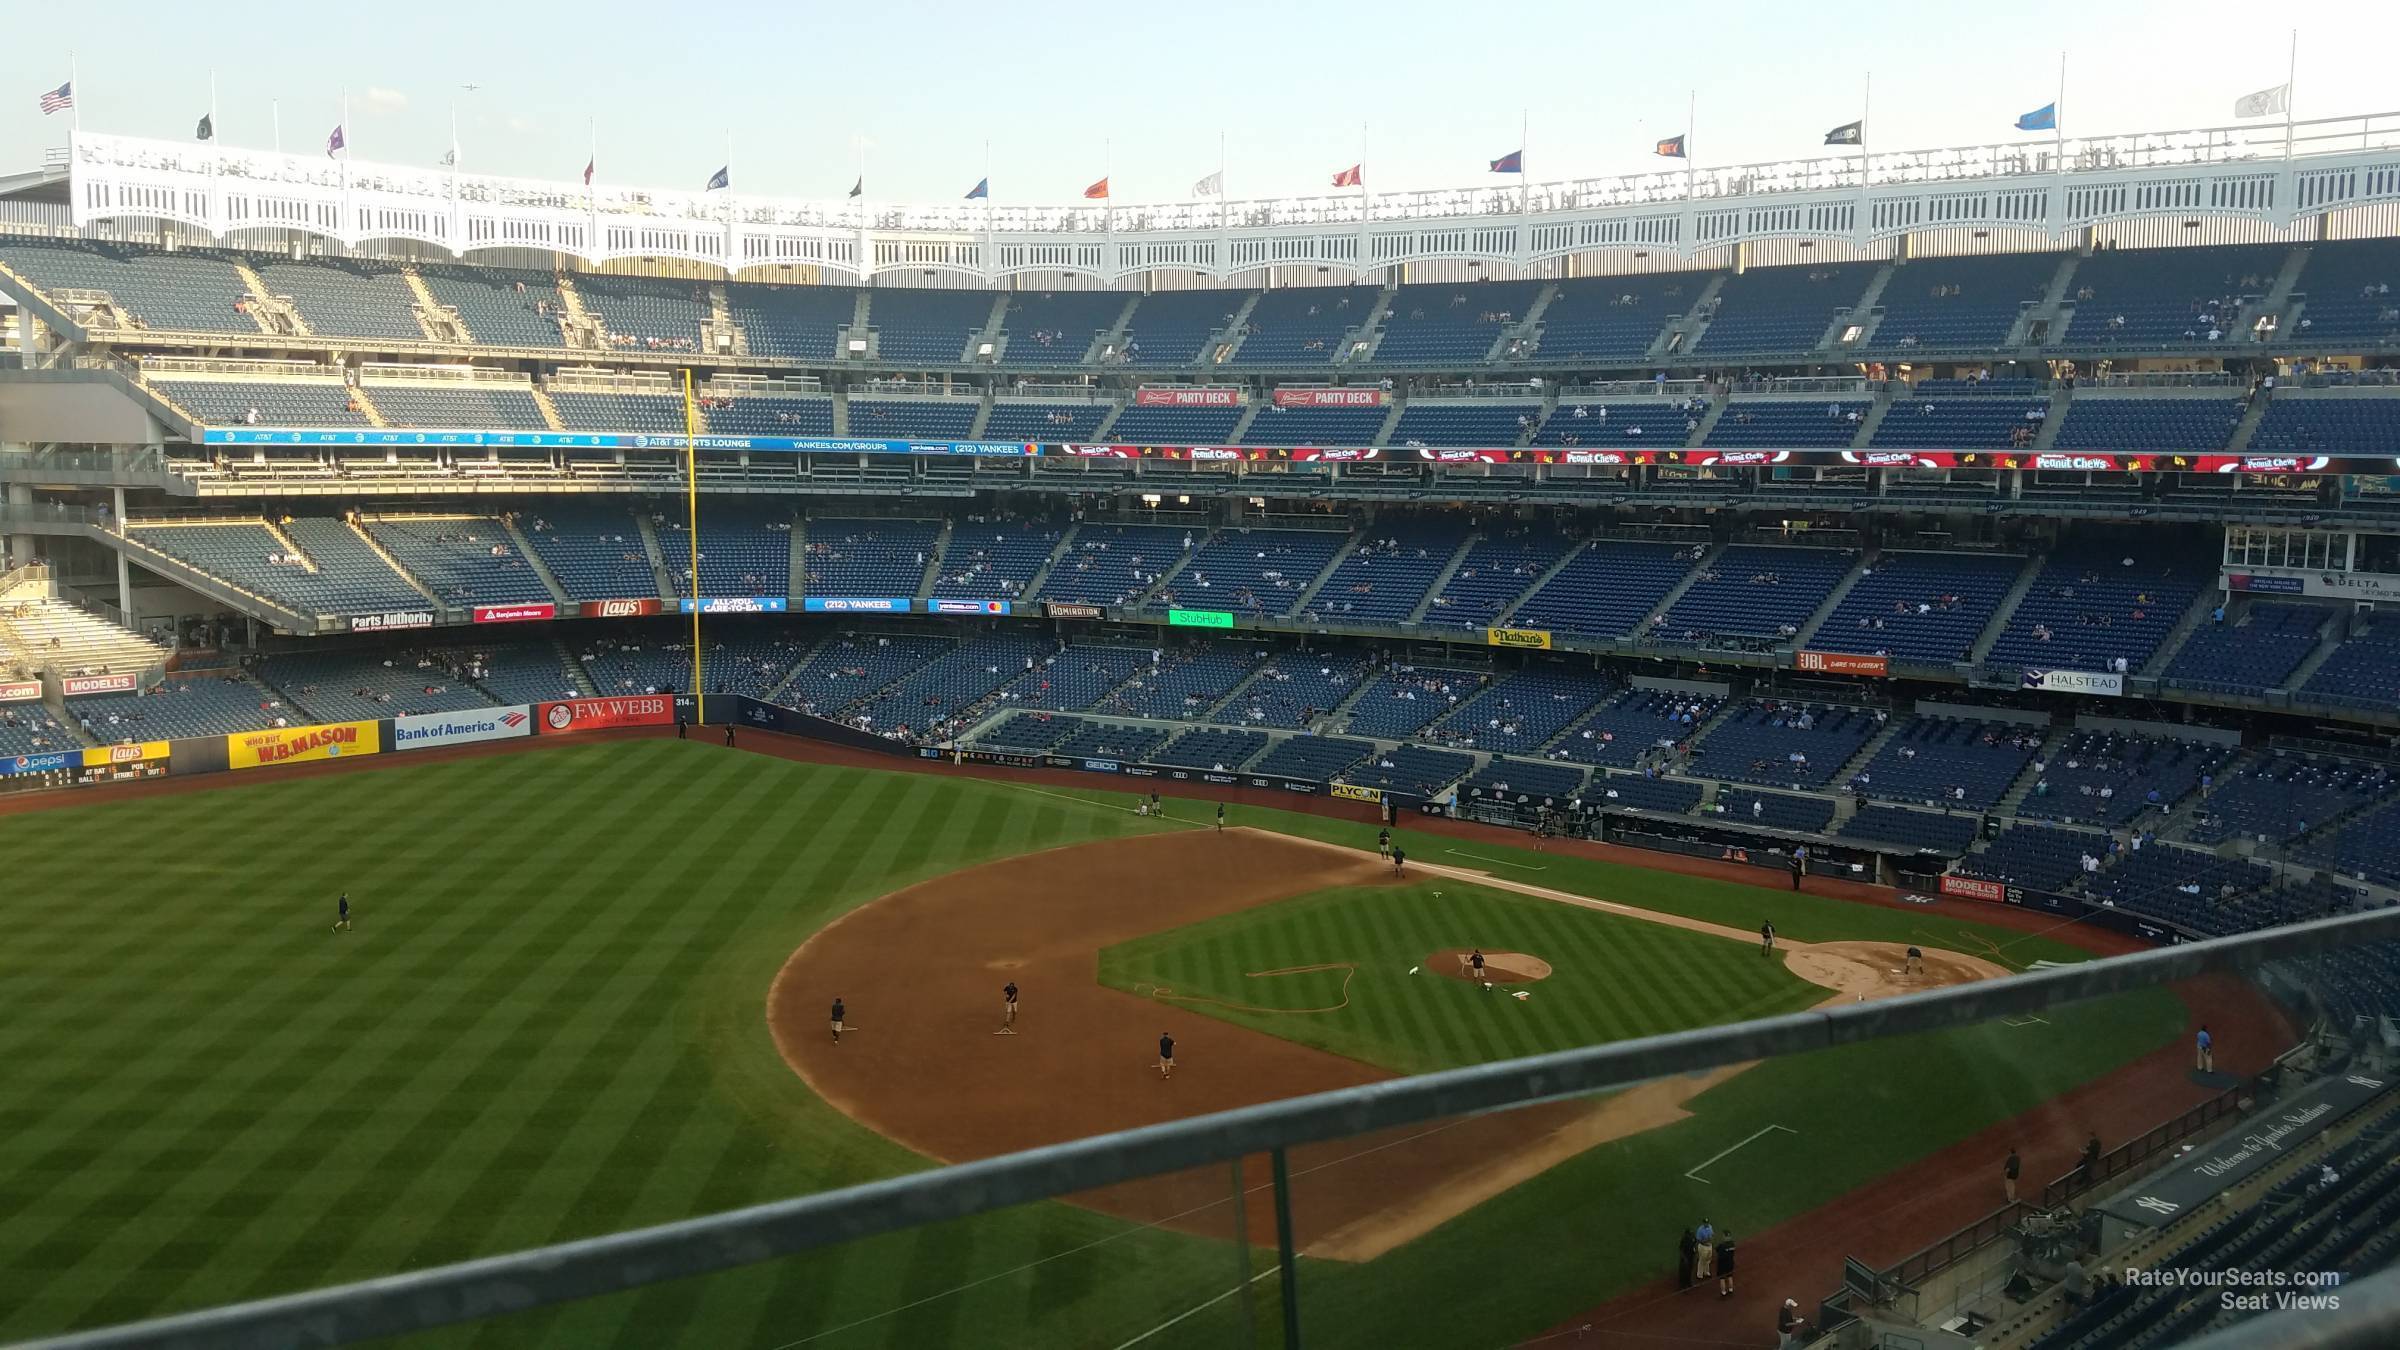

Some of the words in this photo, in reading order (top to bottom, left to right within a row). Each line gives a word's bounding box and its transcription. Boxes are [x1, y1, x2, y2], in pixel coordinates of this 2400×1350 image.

[1177, 392, 1205, 404] PARTY
[1206, 392, 1230, 404] DECK
[1315, 392, 1346, 404] PARTY
[1347, 392, 1373, 404] DECK
[650, 437, 672, 446] AT&T
[712, 439, 751, 448] LOUNGE
[793, 441, 887, 451] YANKEES.COM/GROUPS
[955, 444, 976, 454] (212)
[978, 445, 1019, 454] YANKEES
[2037, 457, 2072, 469] Peanut
[2073, 457, 2107, 469] Chews
[2338, 579, 2379, 588] DELTA
[704, 604, 763, 612] CARE-TO-EAT
[825, 601, 847, 609] (212)
[848, 601, 892, 609] YANKEES
[352, 615, 382, 629] Parts
[383, 612, 434, 626] Authority
[496, 611, 522, 619] Benjamin
[1180, 612, 1223, 625] StubHub
[1494, 629, 1544, 644] Nathan's
[1800, 653, 1828, 670] JBL
[71, 678, 130, 692] MODELL'S
[2051, 674, 2118, 689] HALSTEAD
[611, 699, 664, 716] WEBB
[676, 698, 690, 706] 314
[397, 728, 427, 741] Bank
[429, 724, 444, 737] of
[446, 720, 495, 735] America
[244, 737, 264, 746] WHO
[265, 735, 281, 743] BUT
[31, 754, 65, 769] pepsi
[131, 763, 144, 771] POS
[1085, 759, 1118, 771] GEICO
[113, 771, 134, 779] STRIKE
[147, 768, 160, 776] OUT
[78, 776, 94, 784] BALL
[1945, 879, 1999, 895] MODELL'S
[2194, 1151, 2253, 1177] Welcome
[2245, 1124, 2296, 1151] Yankee
[2283, 1103, 2334, 1127] Stadium
